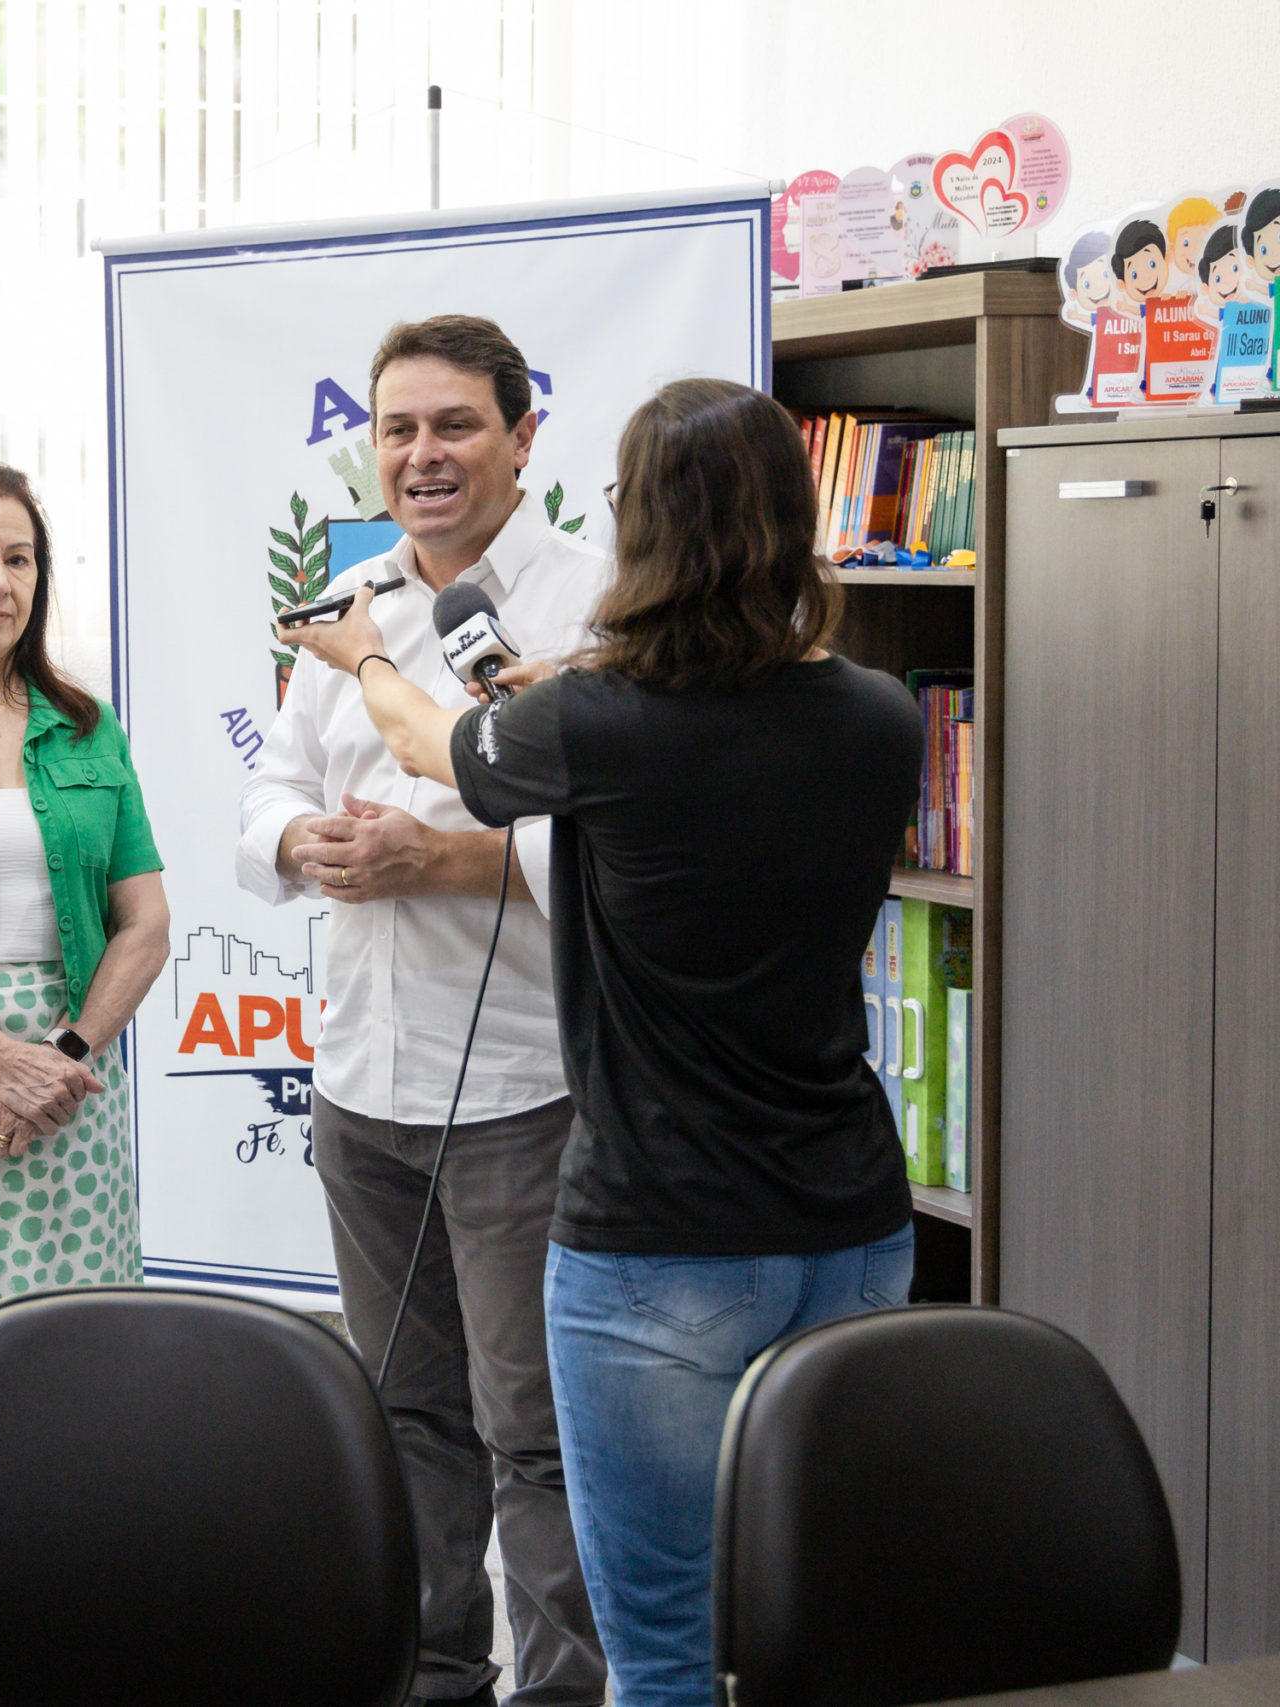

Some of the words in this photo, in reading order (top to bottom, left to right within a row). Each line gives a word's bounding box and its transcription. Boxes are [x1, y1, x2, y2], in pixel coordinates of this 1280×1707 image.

[983, 156, 1002, 166] 2024
[1236, 308, 1270, 325] ALUNO
[1173, 330, 1200, 342] Sarau
[1227, 333, 1237, 356] III
[449, 629, 487, 660] PARANA
[458, 630, 471, 645] TV
